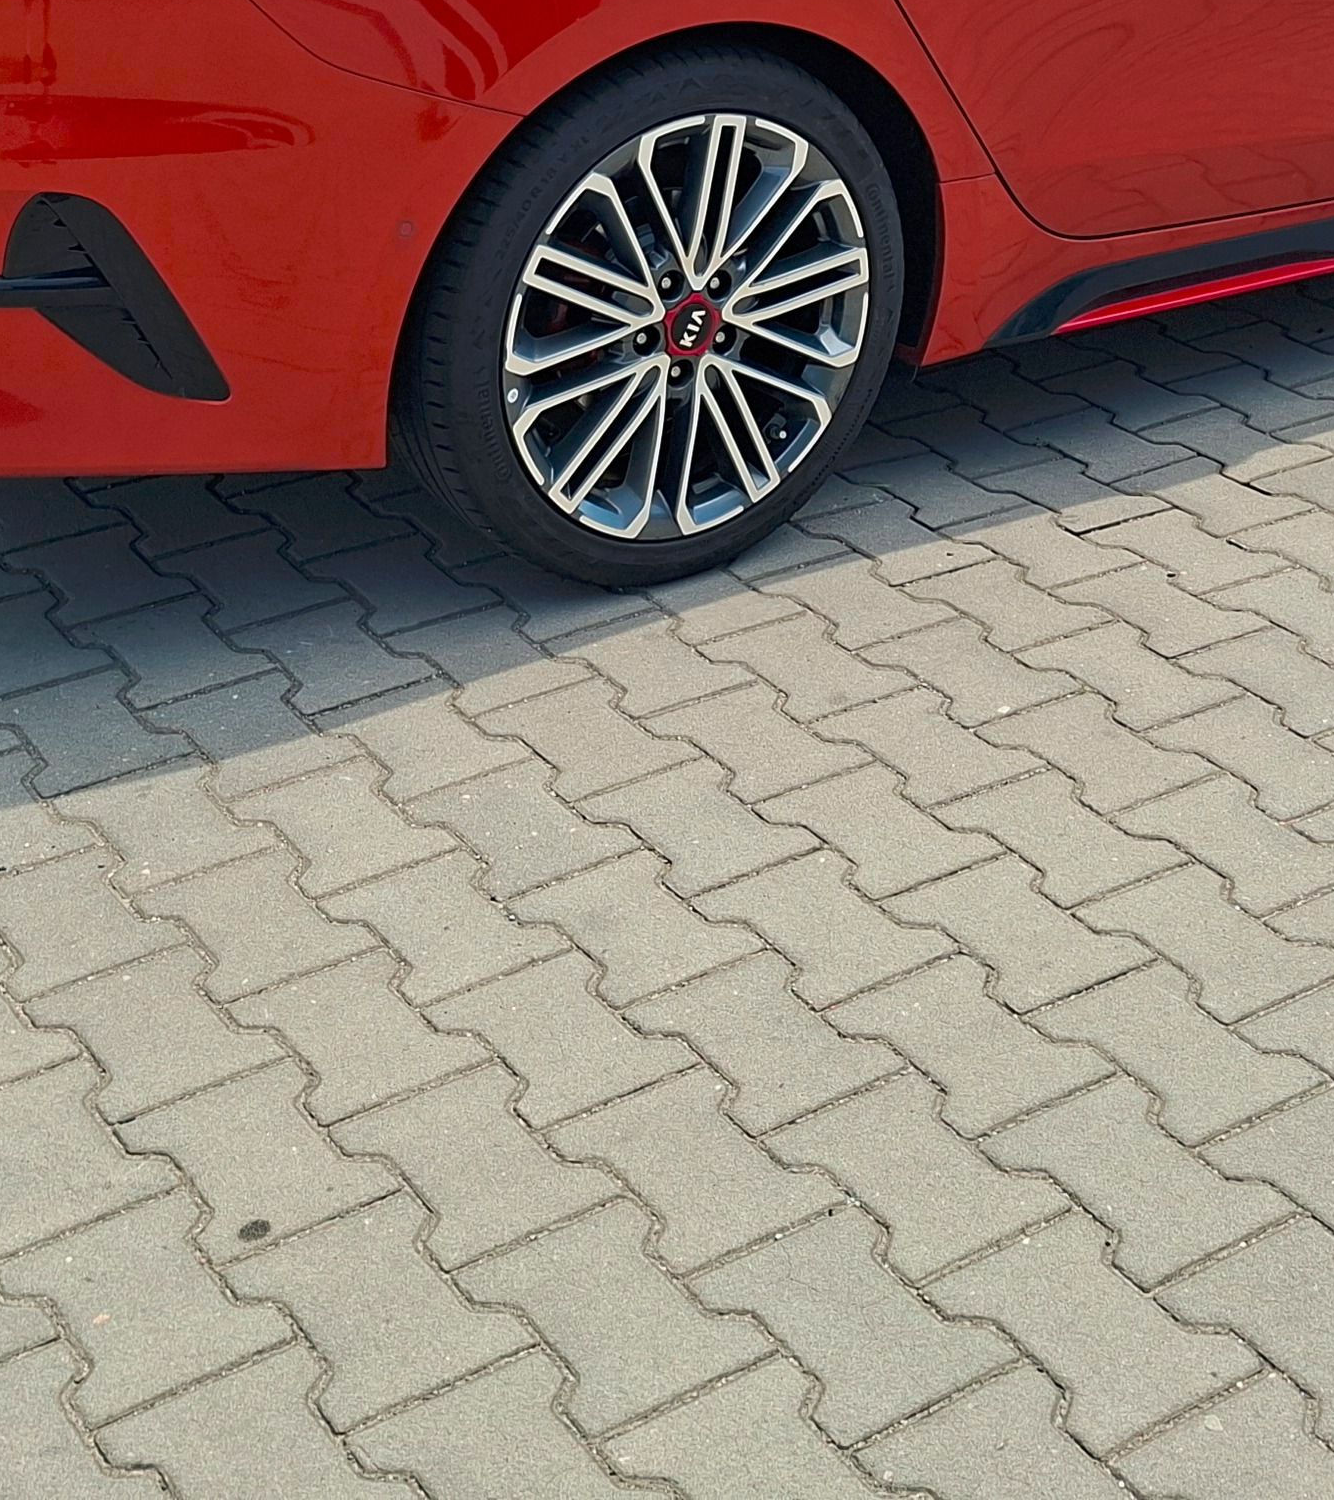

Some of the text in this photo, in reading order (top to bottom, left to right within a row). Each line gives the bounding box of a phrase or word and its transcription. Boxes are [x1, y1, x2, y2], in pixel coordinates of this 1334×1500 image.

[866, 182, 896, 280] Continental
[679, 310, 706, 349] KIA
[475, 380, 513, 482] Continental
